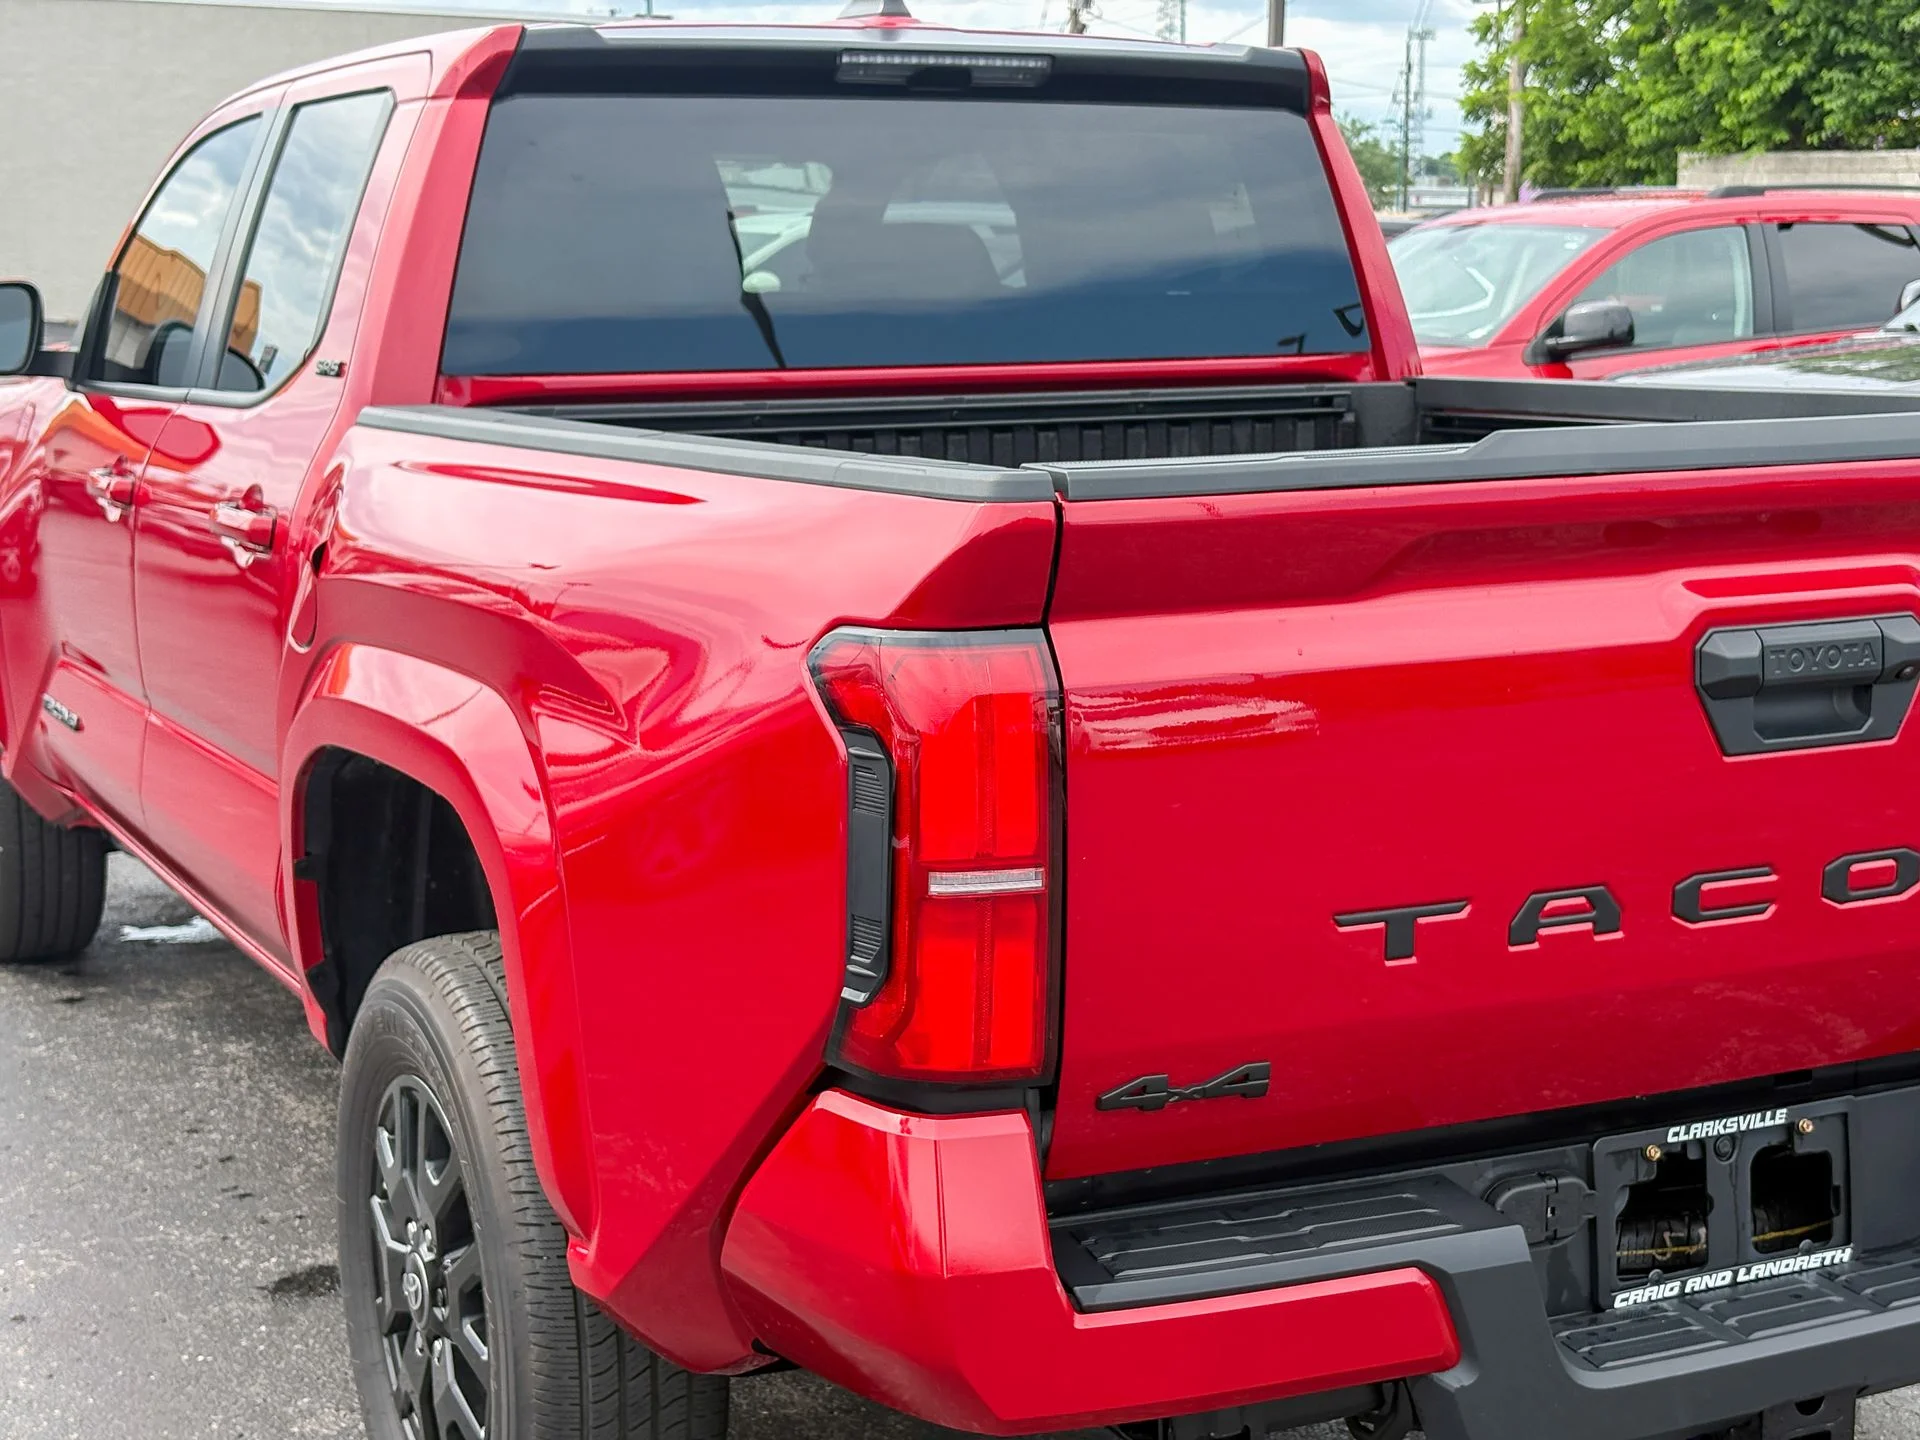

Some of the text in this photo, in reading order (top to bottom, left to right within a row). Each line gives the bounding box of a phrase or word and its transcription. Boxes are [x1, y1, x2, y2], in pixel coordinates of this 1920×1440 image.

[1768, 642, 1877, 675] TOYOTA
[1333, 847, 1920, 962] TACO
[1667, 1108, 1788, 1143] CLARKSVILLE
[1613, 1247, 1854, 1309] CRAIG AND LANDRETH
